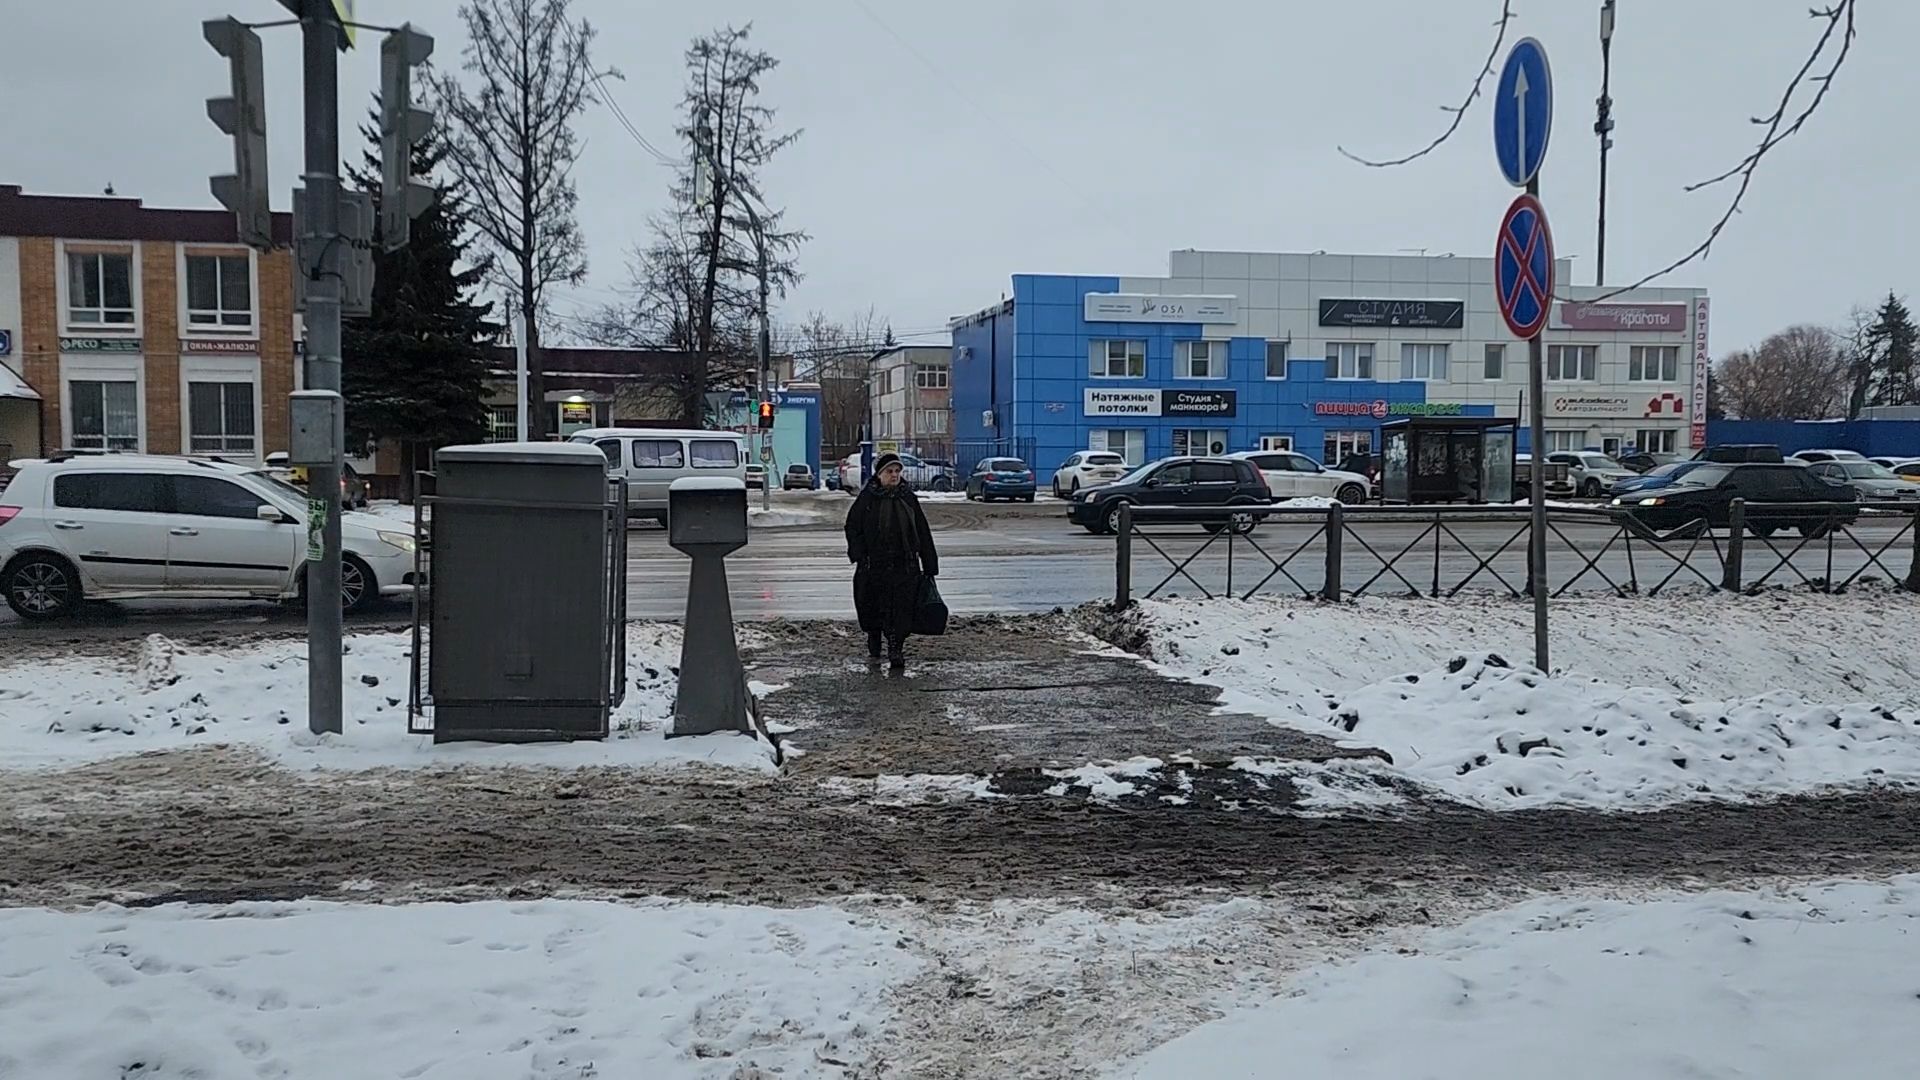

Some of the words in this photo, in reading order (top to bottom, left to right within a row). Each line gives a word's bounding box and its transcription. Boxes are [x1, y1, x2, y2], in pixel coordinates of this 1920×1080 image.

[1160, 304, 1185, 314] OSA
[1358, 302, 1426, 315] СТУДИЯ
[71, 340, 98, 349] РЕСО
[1694, 302, 1707, 421] АВТОЗАПЧАСТИ
[1091, 392, 1155, 402] Натяжные
[1177, 393, 1212, 404] Студия
[1098, 404, 1148, 413] потолки
[1169, 403, 1219, 413] маникюра
[1315, 402, 1370, 416] пицца
[1389, 402, 1462, 416] экспресс
